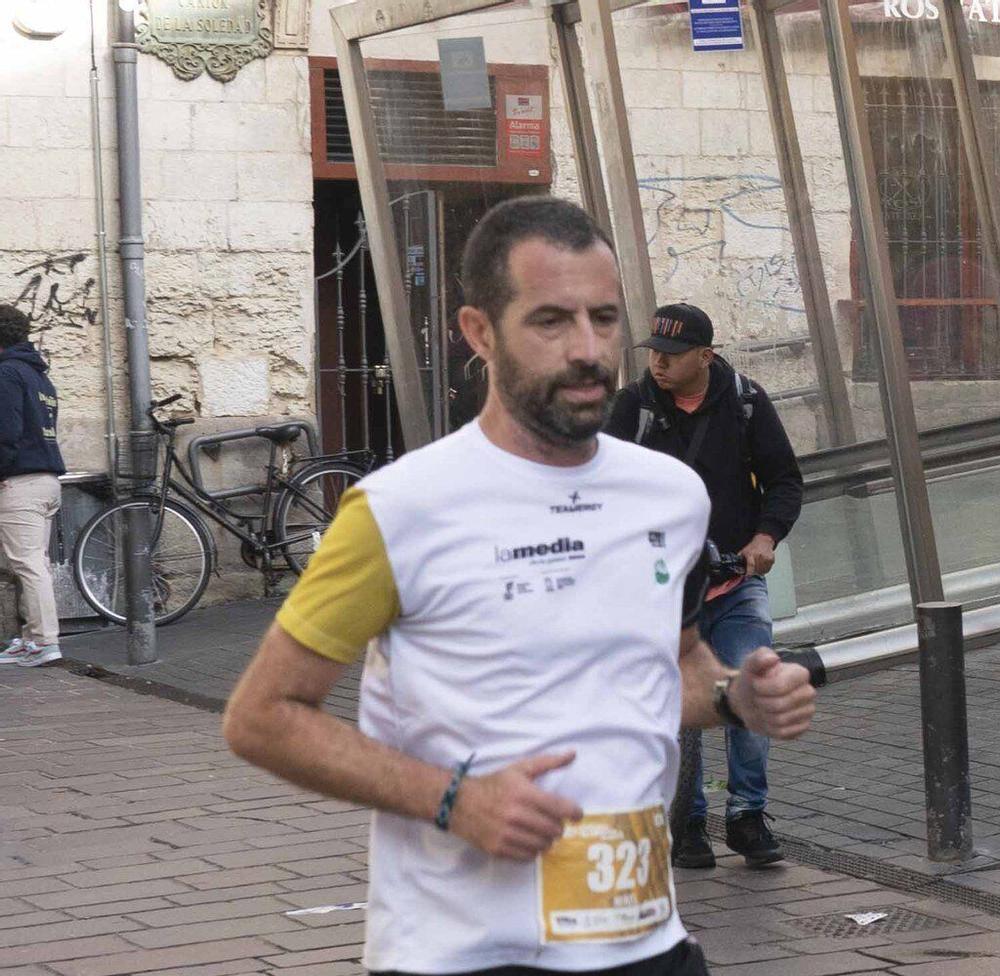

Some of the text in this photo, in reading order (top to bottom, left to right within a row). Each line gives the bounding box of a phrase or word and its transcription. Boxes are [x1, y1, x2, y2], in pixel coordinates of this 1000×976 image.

[175, 17, 193, 32] LA
[494, 536, 585, 563] lamedia
[587, 837, 652, 893] 323
